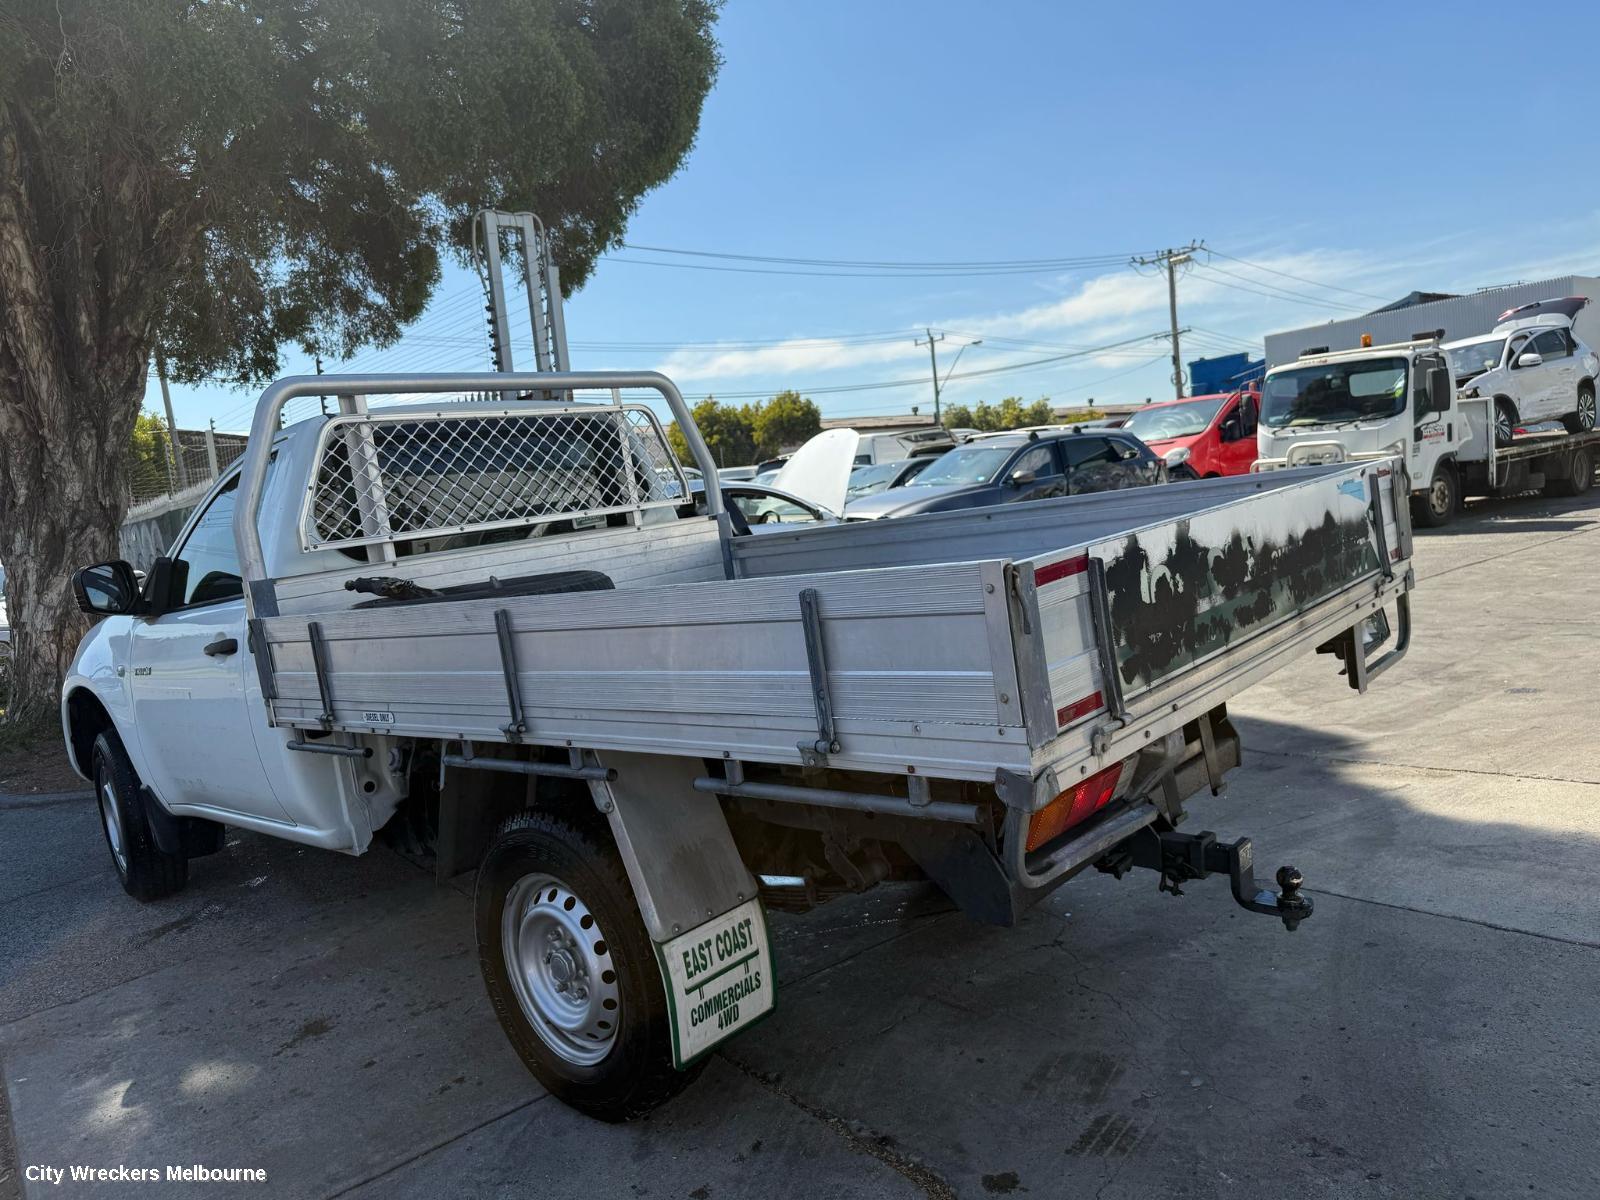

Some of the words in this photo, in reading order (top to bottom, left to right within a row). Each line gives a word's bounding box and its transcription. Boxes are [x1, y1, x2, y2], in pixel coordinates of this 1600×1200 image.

[682, 938, 714, 980] EAST
[715, 918, 753, 962] COAST
[690, 971, 762, 1027] COMMERCIALS
[717, 1003, 740, 1031] 4WD
